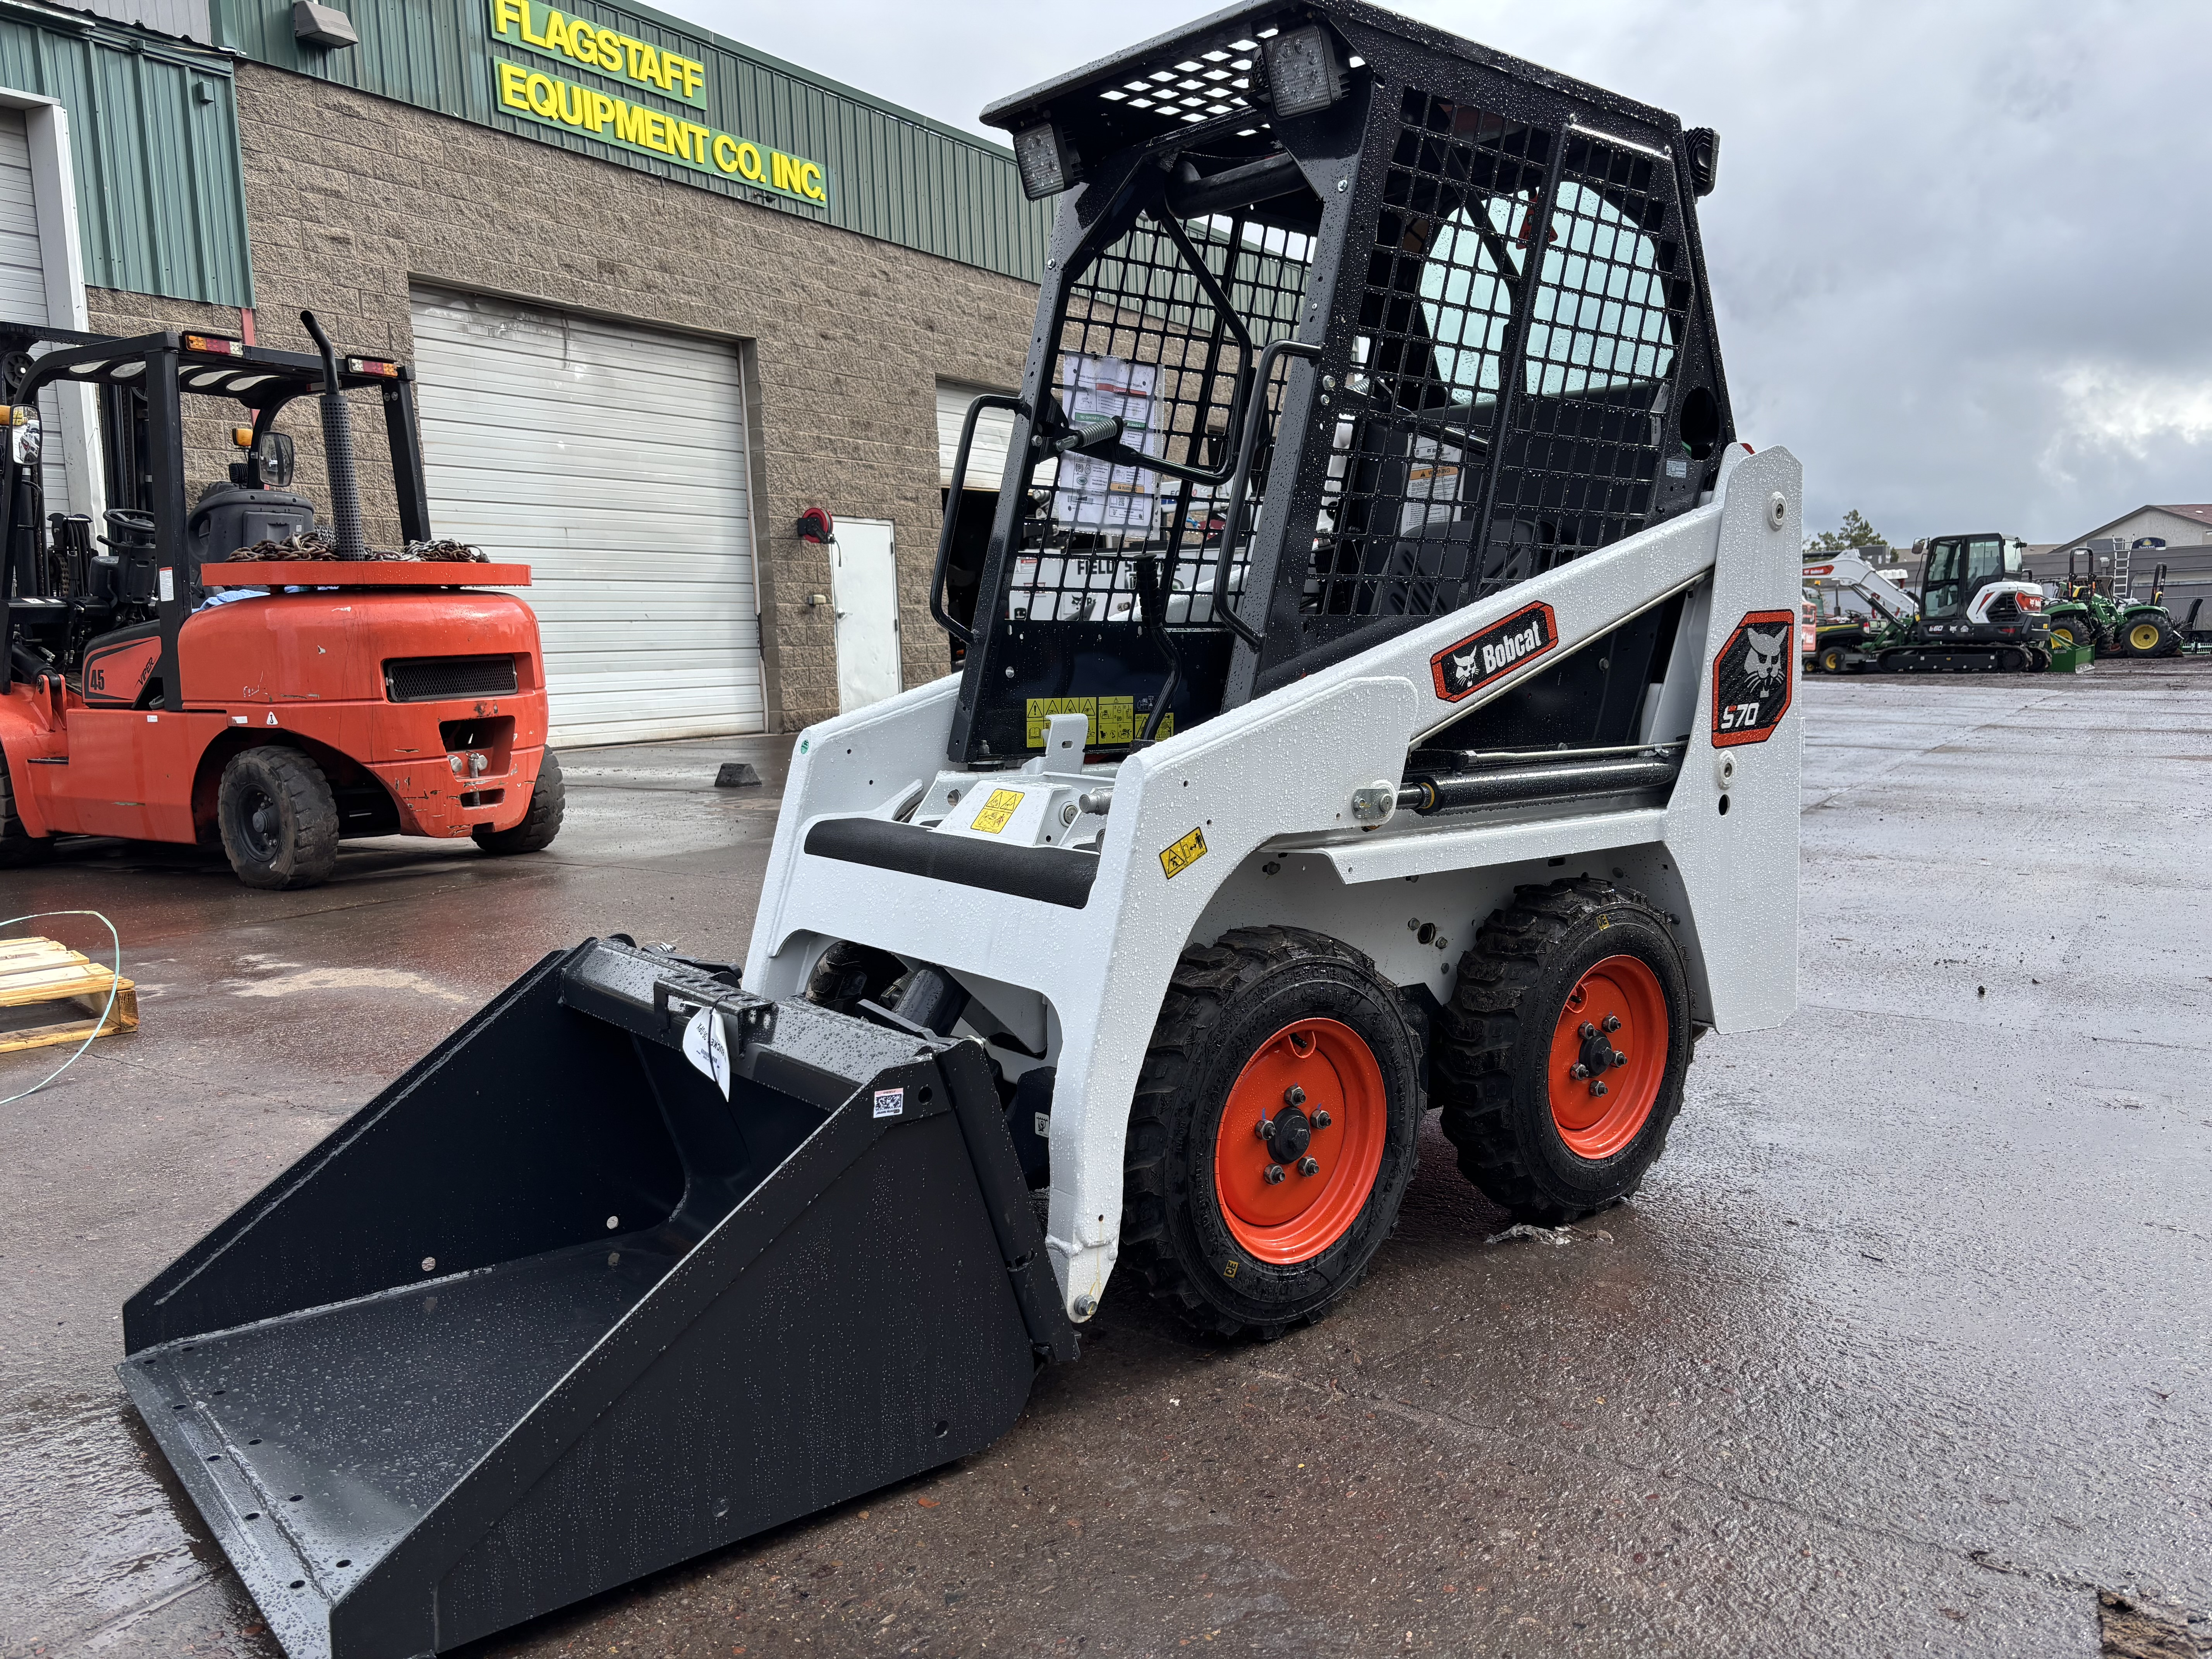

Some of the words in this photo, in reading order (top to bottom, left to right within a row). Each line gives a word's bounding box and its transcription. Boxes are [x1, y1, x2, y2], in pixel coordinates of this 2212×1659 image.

[495, 0, 704, 98] FLAGSTAFF
[499, 63, 709, 164] EQUIPMENT
[713, 134, 766, 184] CO.
[771, 151, 826, 201] INC.
[1482, 620, 1541, 674] Bobcat
[91, 669, 105, 690] 45
[136, 657, 154, 687] VIPER
[1721, 702, 1760, 729] S70
[1225, 1261, 1237, 1275] OE
